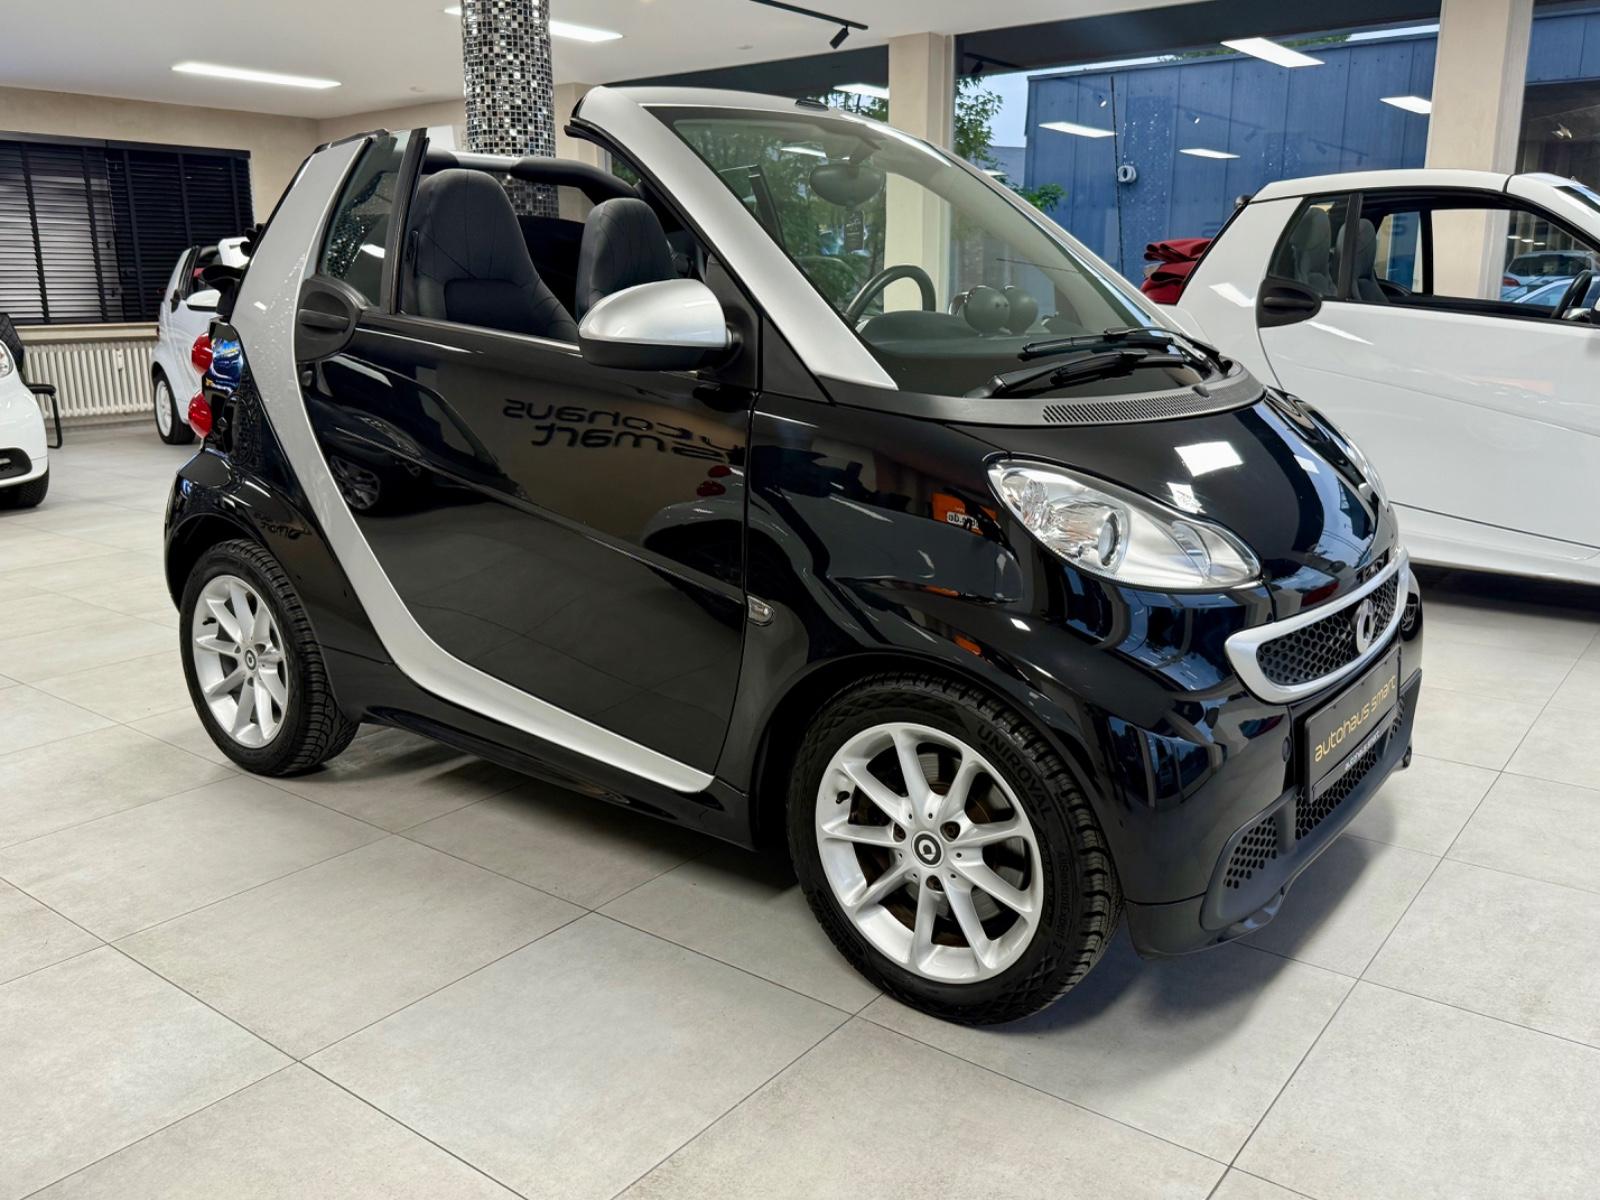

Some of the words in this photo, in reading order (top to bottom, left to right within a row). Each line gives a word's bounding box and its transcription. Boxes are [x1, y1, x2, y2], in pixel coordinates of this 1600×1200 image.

[1314, 703, 1370, 762] autohaus
[1371, 675, 1396, 711] smart
[977, 726, 1052, 821] UNIROYAL
